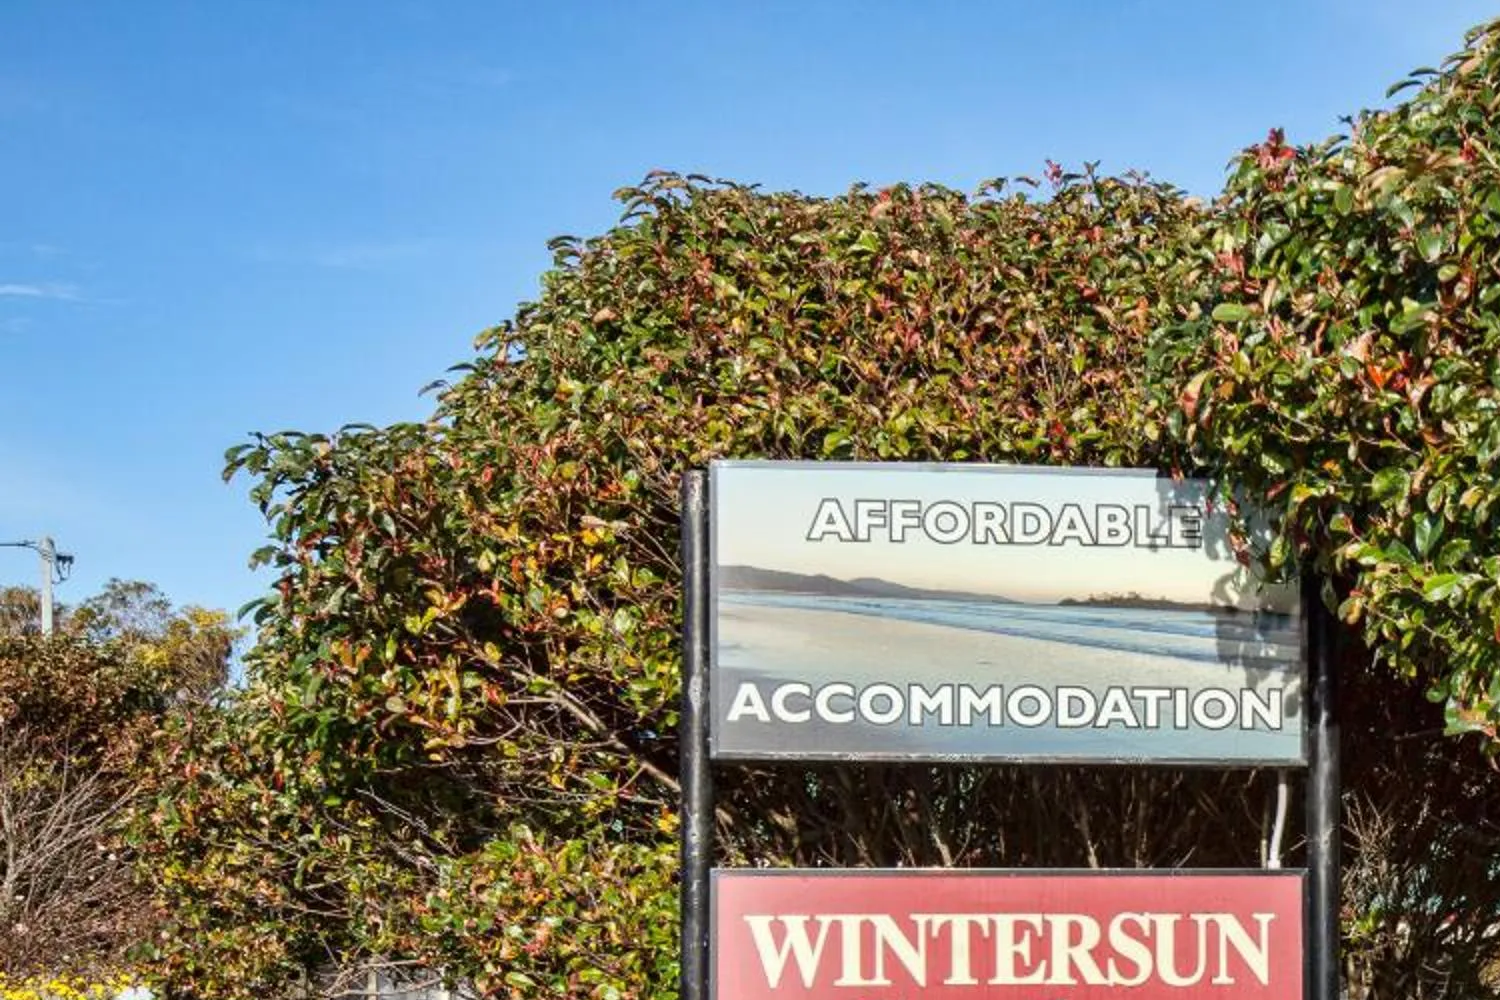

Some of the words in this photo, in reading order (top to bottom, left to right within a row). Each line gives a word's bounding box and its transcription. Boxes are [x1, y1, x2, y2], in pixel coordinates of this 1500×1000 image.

[806, 498, 1203, 548] AFFORDABLE
[727, 682, 1284, 731] ACCOMMODATION
[743, 912, 1276, 989] WINTERSUN
